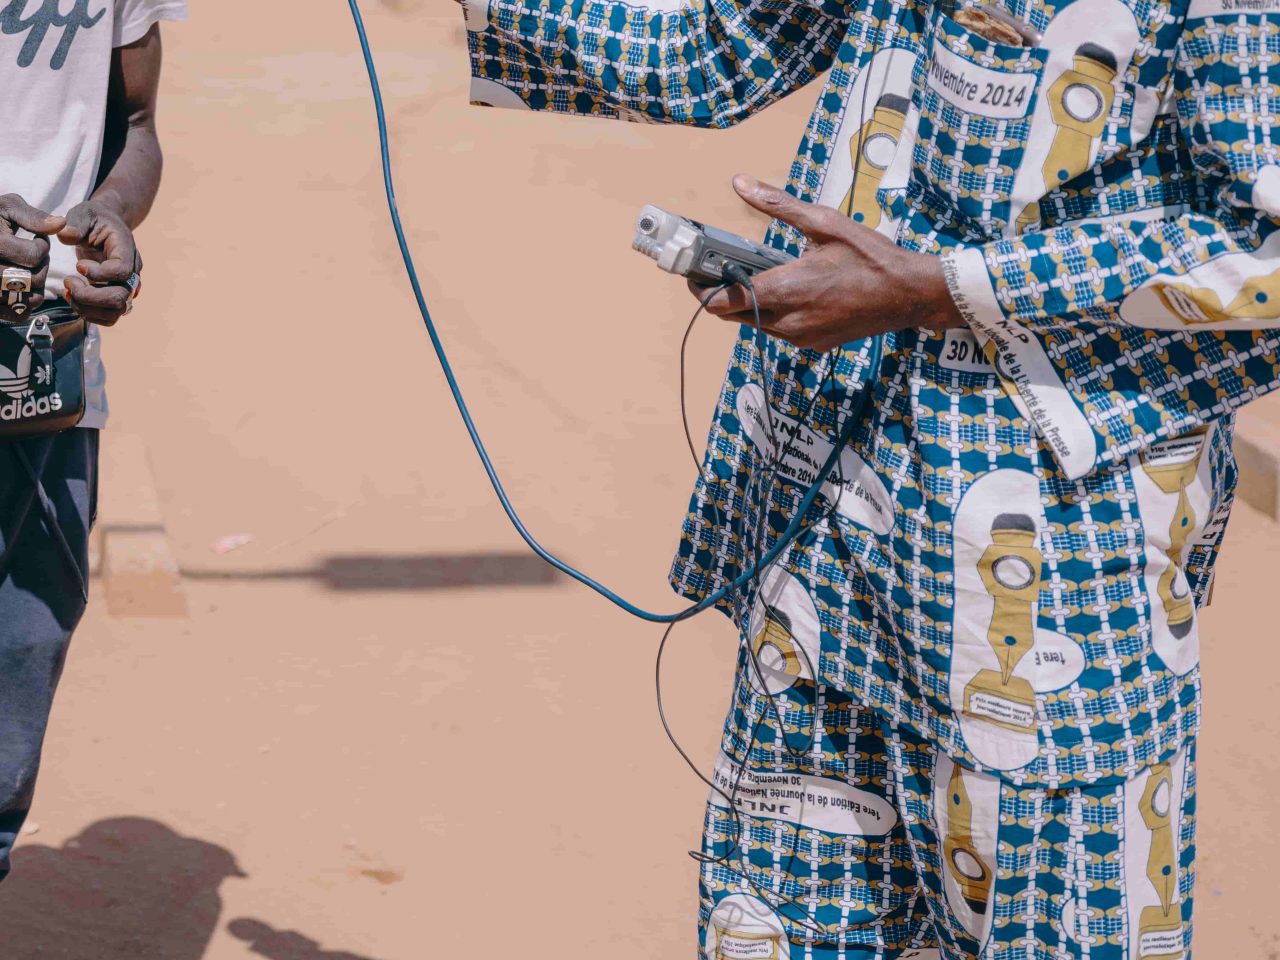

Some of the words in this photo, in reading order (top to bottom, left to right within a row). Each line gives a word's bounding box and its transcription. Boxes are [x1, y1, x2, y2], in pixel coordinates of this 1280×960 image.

[980, 82, 1027, 108] 2014
[1003, 351, 1017, 365] de
[1010, 363, 1022, 377] la
[1015, 375, 1040, 408] Liberté
[1033, 407, 1047, 421] de
[1041, 418, 1052, 428] la
[1048, 426, 1071, 458] Presse
[1043, 651, 1066, 665] 1ere
[748, 773, 789, 785] Novembre
[791, 776, 802, 786] 30
[770, 788, 805, 803] Journée
[807, 793, 815, 805] la
[817, 795, 828, 807] de
[830, 796, 861, 813] Edition
[863, 805, 881, 821] 1ere
